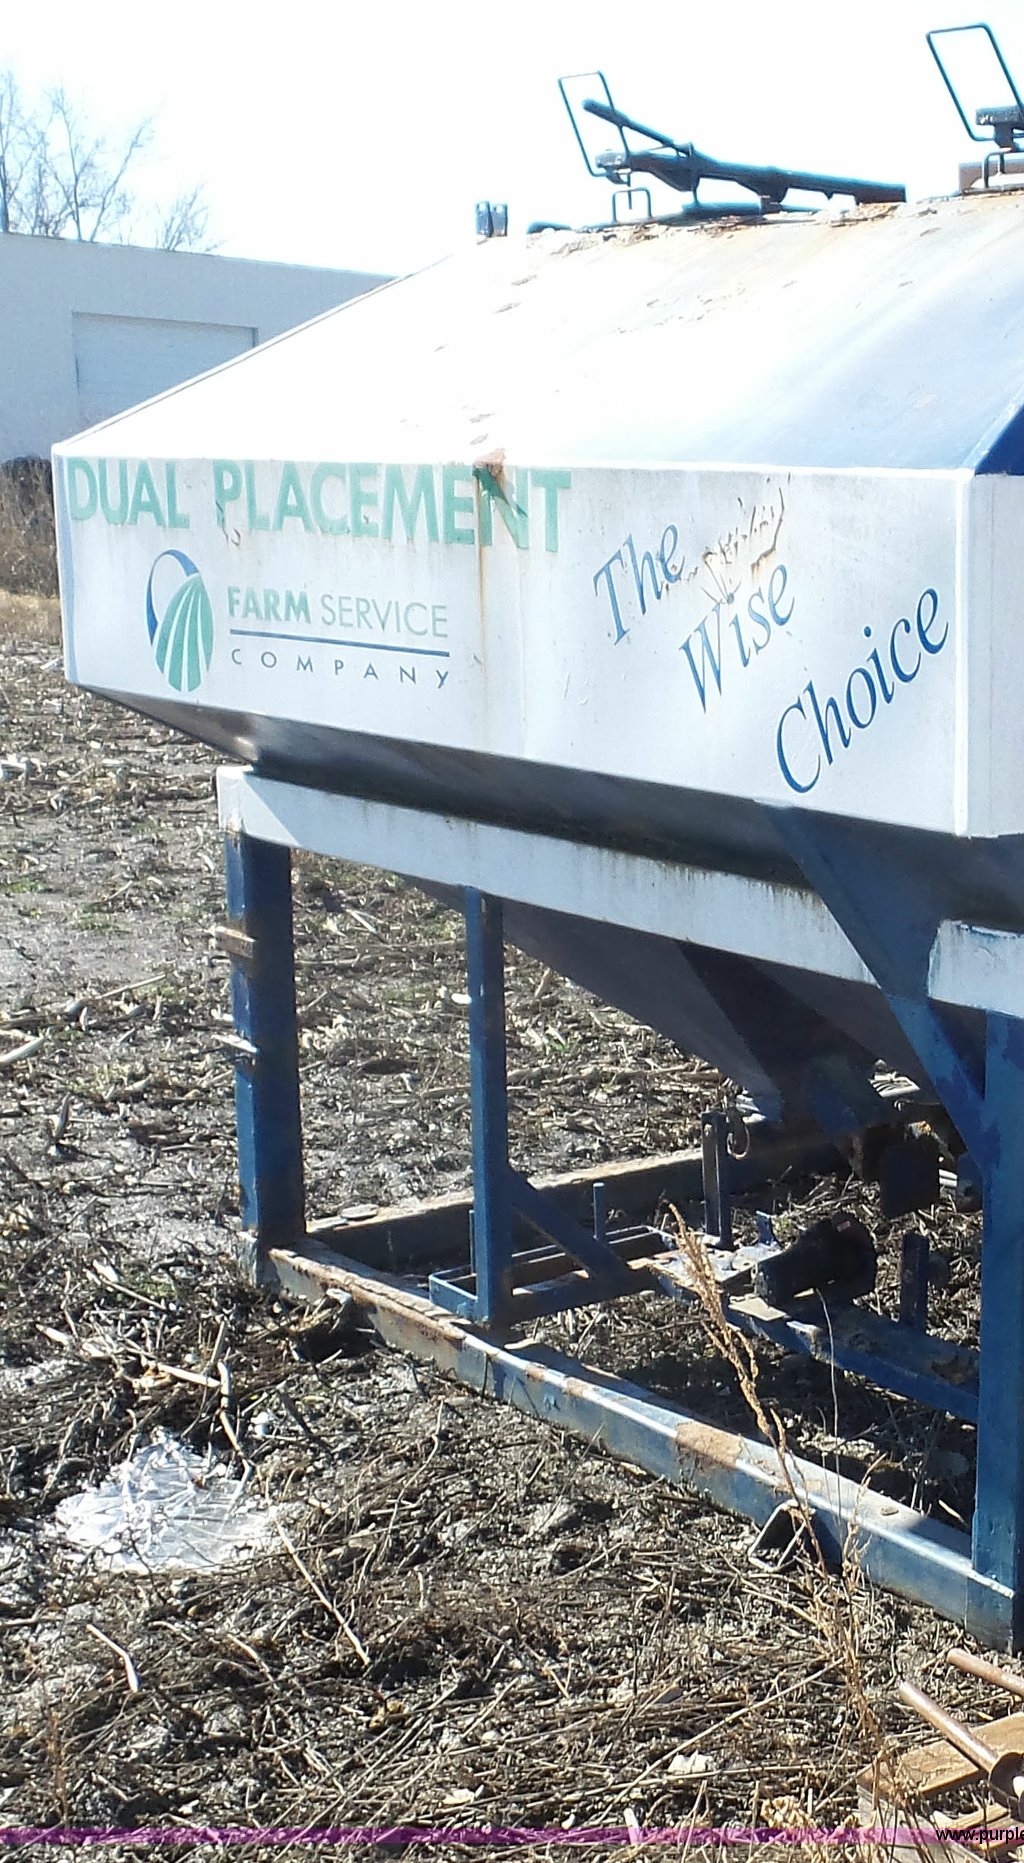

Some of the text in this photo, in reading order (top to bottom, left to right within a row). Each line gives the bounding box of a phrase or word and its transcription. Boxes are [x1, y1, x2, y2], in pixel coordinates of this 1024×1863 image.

[67, 457, 572, 553] DUAL PLACEMENT
[227, 585, 448, 638] FARM SERVICE
[593, 525, 685, 645] The
[679, 564, 795, 714] Wise
[231, 648, 449, 688] COMPANY
[776, 588, 949, 794] Choice
